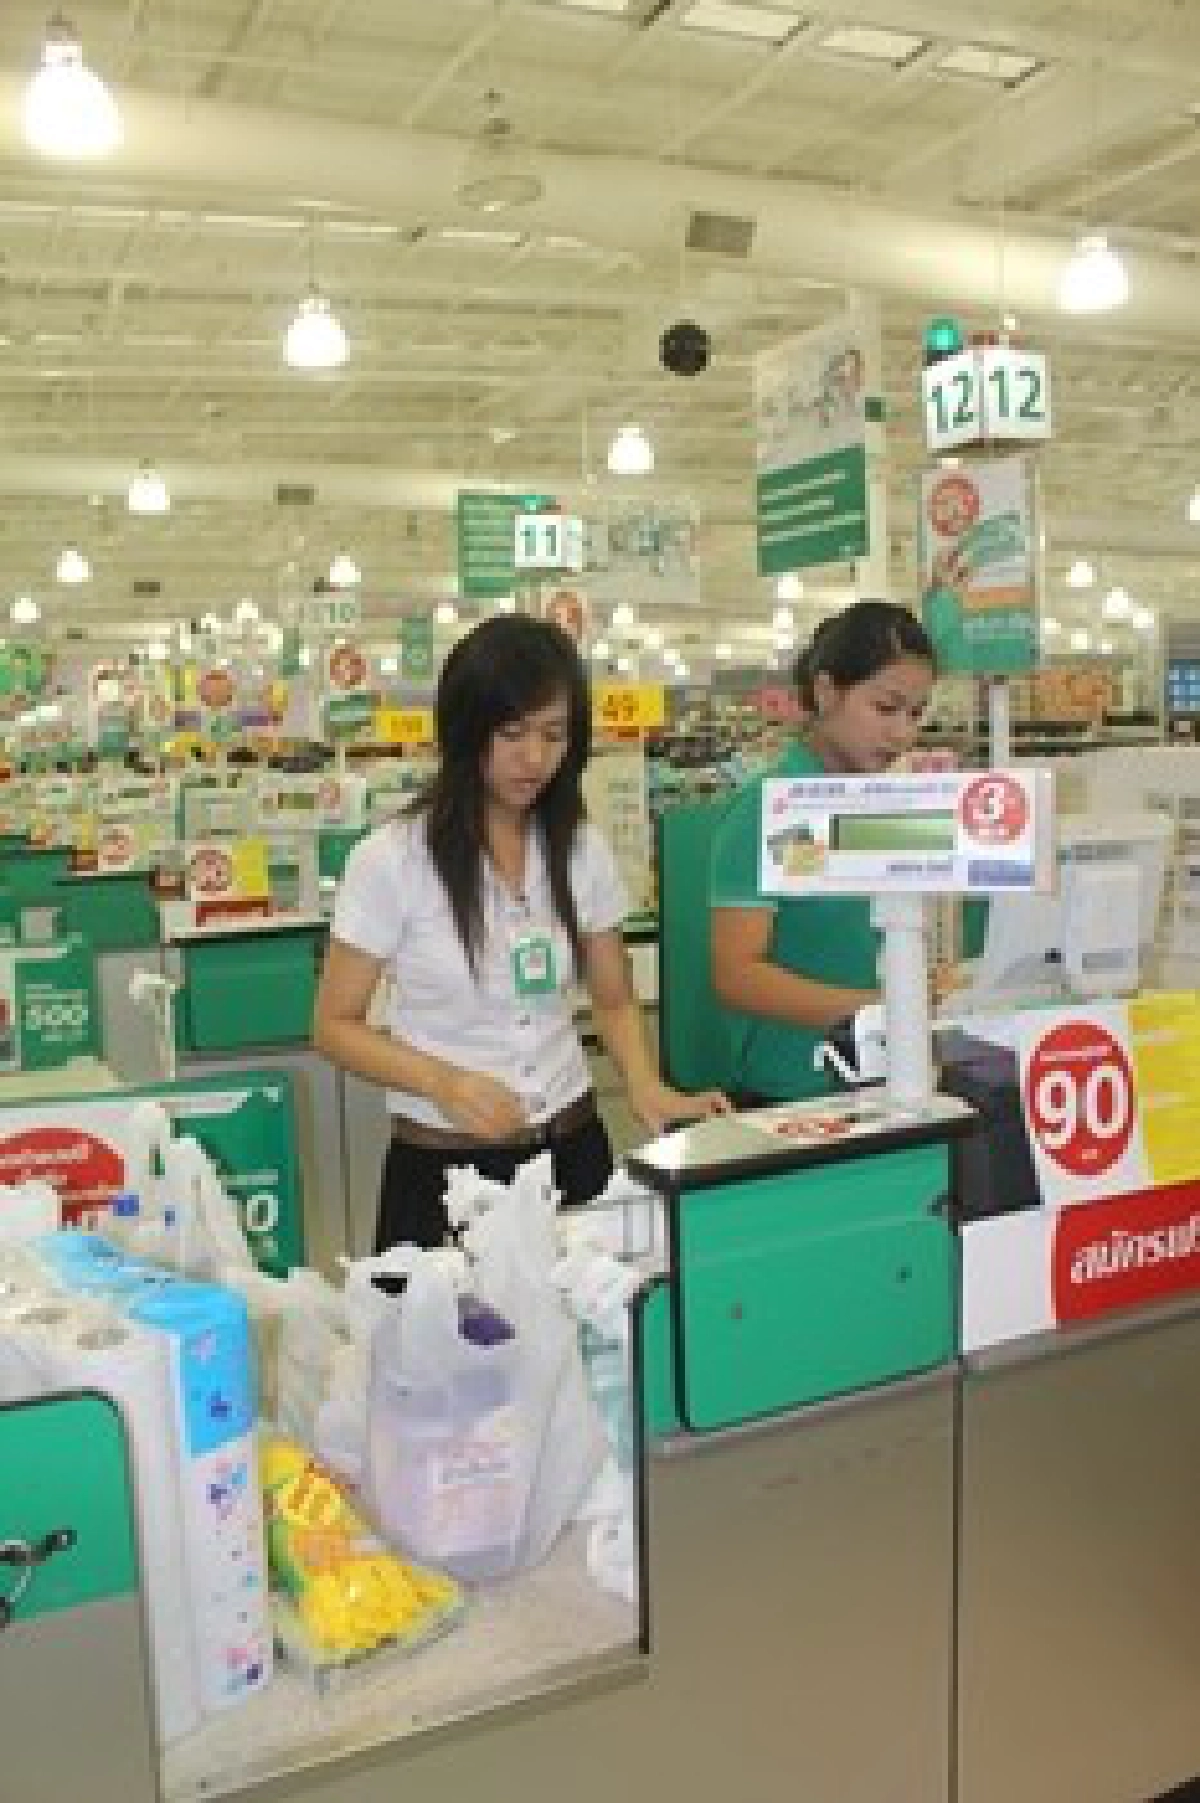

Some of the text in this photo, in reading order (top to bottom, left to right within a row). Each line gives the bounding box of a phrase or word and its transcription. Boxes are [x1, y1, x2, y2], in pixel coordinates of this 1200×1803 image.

[930, 372, 975, 434] 12
[987, 364, 1046, 418] 12
[519, 522, 558, 556] 11
[973, 779, 1005, 823] 3
[1034, 1065, 1126, 1148] 90
